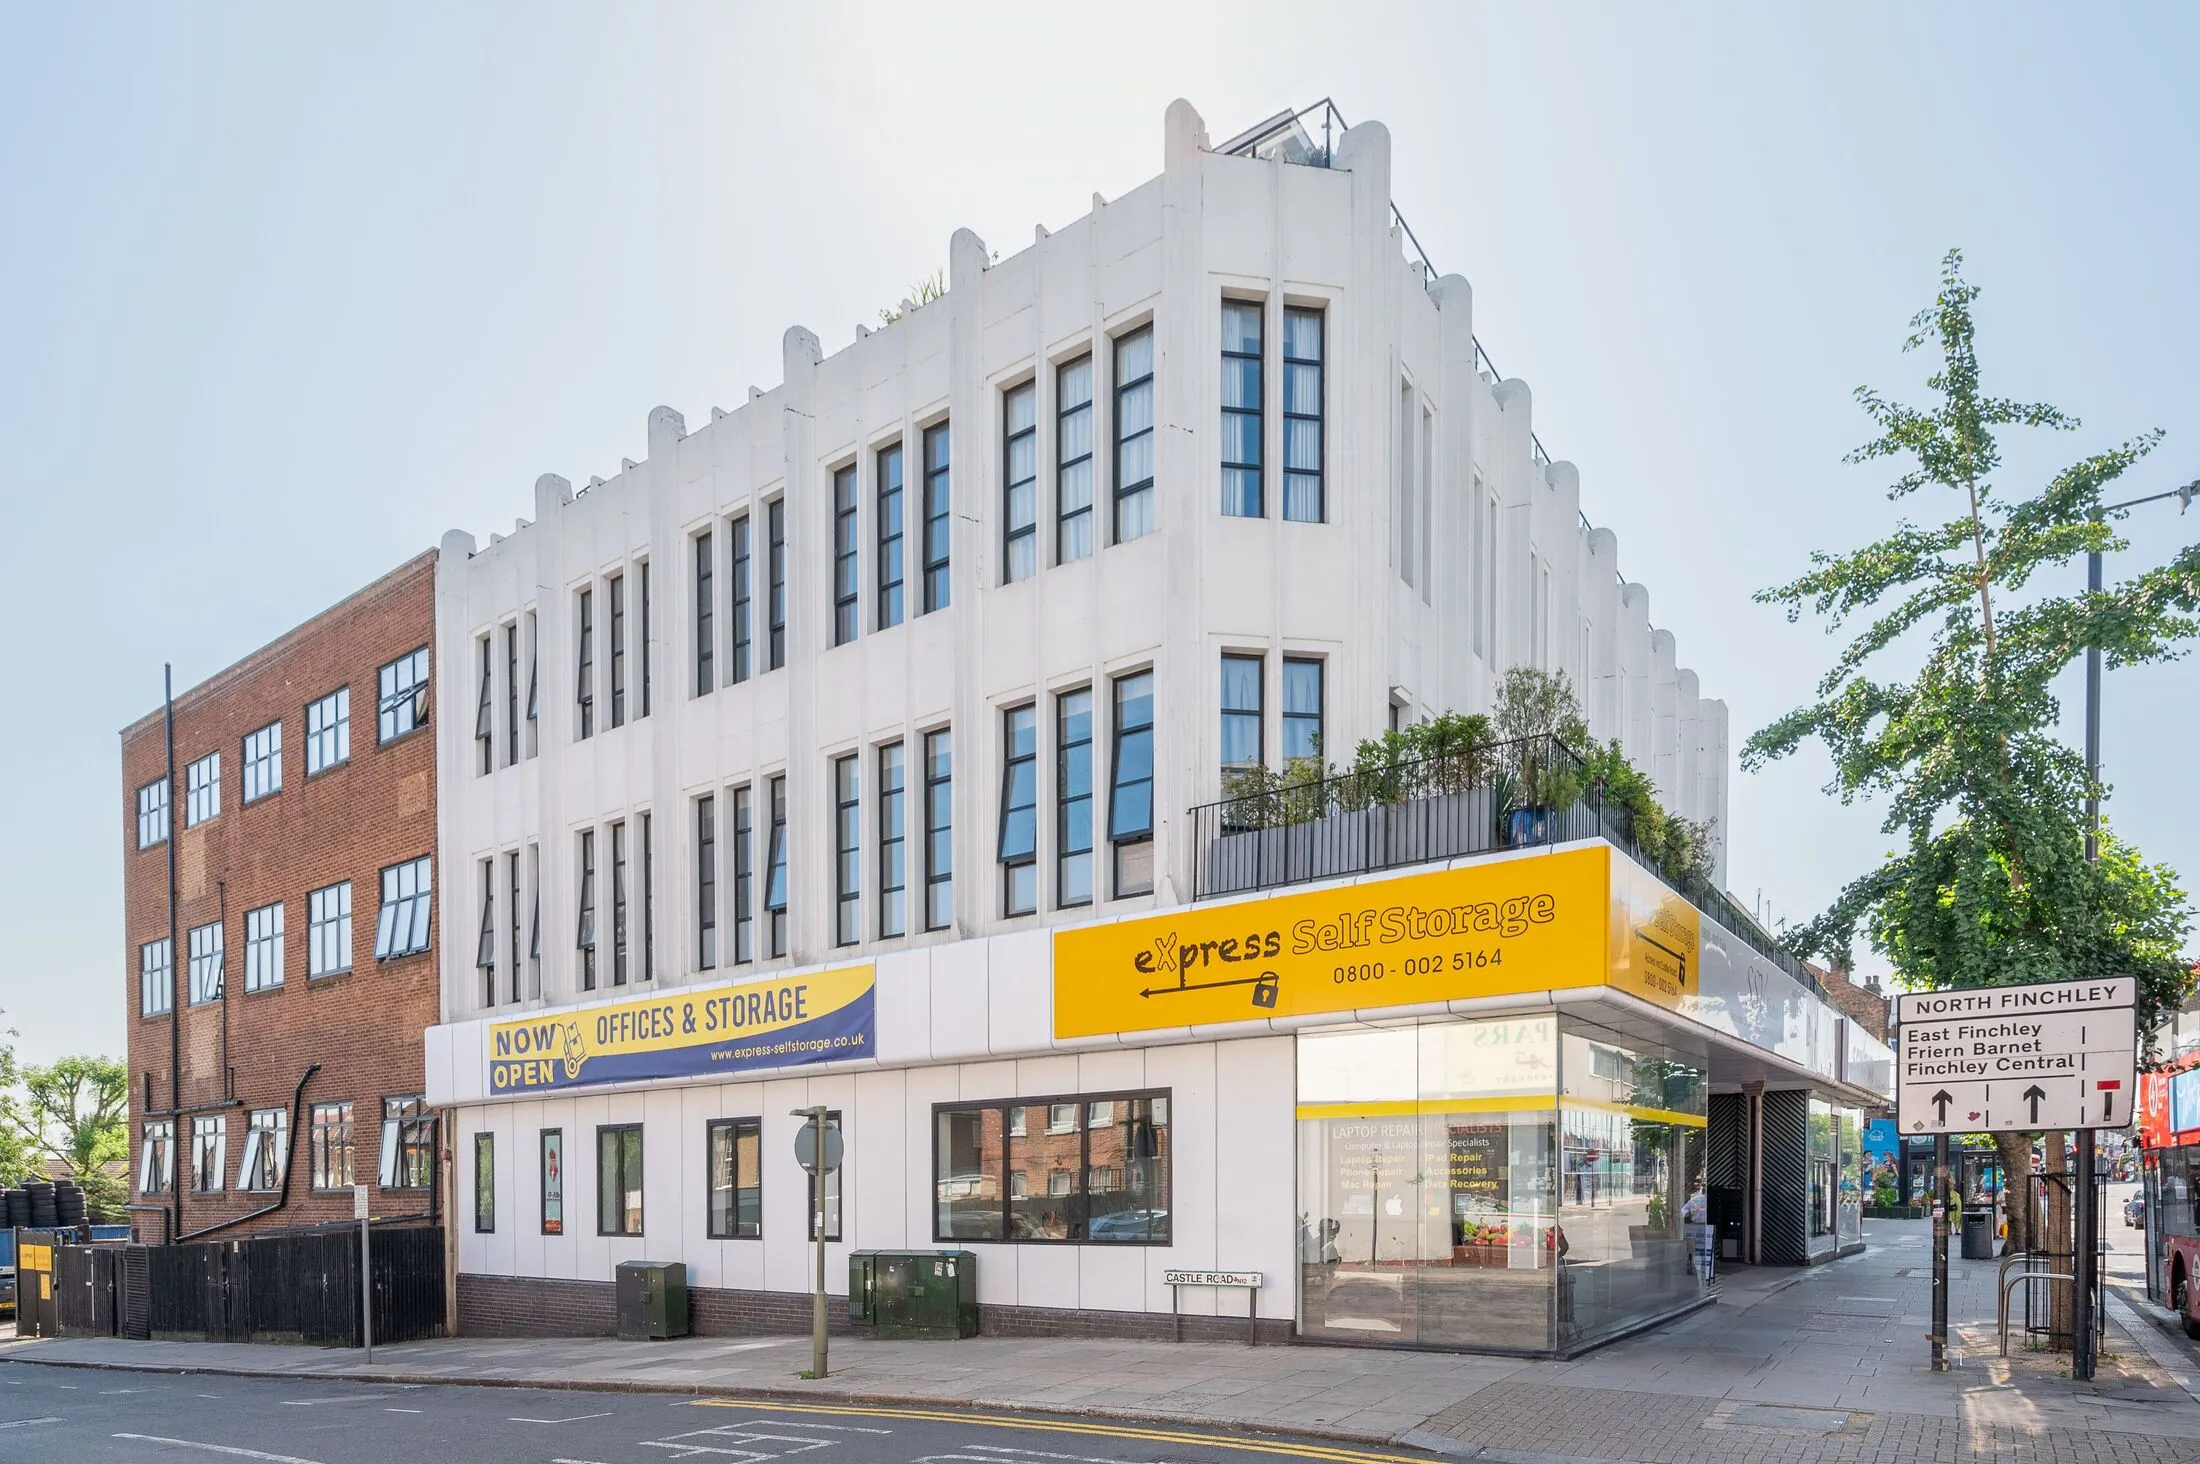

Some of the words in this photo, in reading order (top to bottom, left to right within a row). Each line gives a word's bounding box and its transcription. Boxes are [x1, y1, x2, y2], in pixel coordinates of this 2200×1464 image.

[1134, 930, 1281, 989] eXpress
[1292, 909, 1377, 955] Self
[1380, 893, 1555, 944] Storage
[1334, 962, 1384, 984] 0800
[1404, 955, 1443, 976] 002
[1452, 948, 1502, 970] 5164
[1916, 995, 1991, 1015] NORTH
[2001, 985, 2117, 1008] FINCHLEY
[596, 1004, 675, 1045] OFFICES
[682, 1002, 697, 1035] &
[705, 985, 808, 1032] STORAGE
[496, 1022, 556, 1056] NOW
[1908, 1027, 1950, 1043] East
[1958, 1023, 2043, 1040] Finchley
[711, 1032, 865, 1062] www.express-selfstorage.co.uk
[1908, 1045, 1965, 1060] Friern
[1973, 1039, 2042, 1056] Barnet
[493, 1060, 555, 1089] OPEN
[1908, 1060, 1988, 1076] Finchley
[1996, 1054, 2075, 1072] Central
[1333, 1125, 1377, 1139] LAPTOP
[1381, 1123, 1424, 1137] REPAIR
[1428, 1122, 1502, 1135] ECIALISTS
[1448, 1138, 1490, 1149] Specialists
[1450, 1153, 1483, 1163] Repair
[1426, 1166, 1488, 1176] Accessories
[1450, 1179, 1498, 1190] Recovery
[1166, 1273, 1203, 1284] CASTLE
[1206, 1274, 1234, 1284] ROAD
